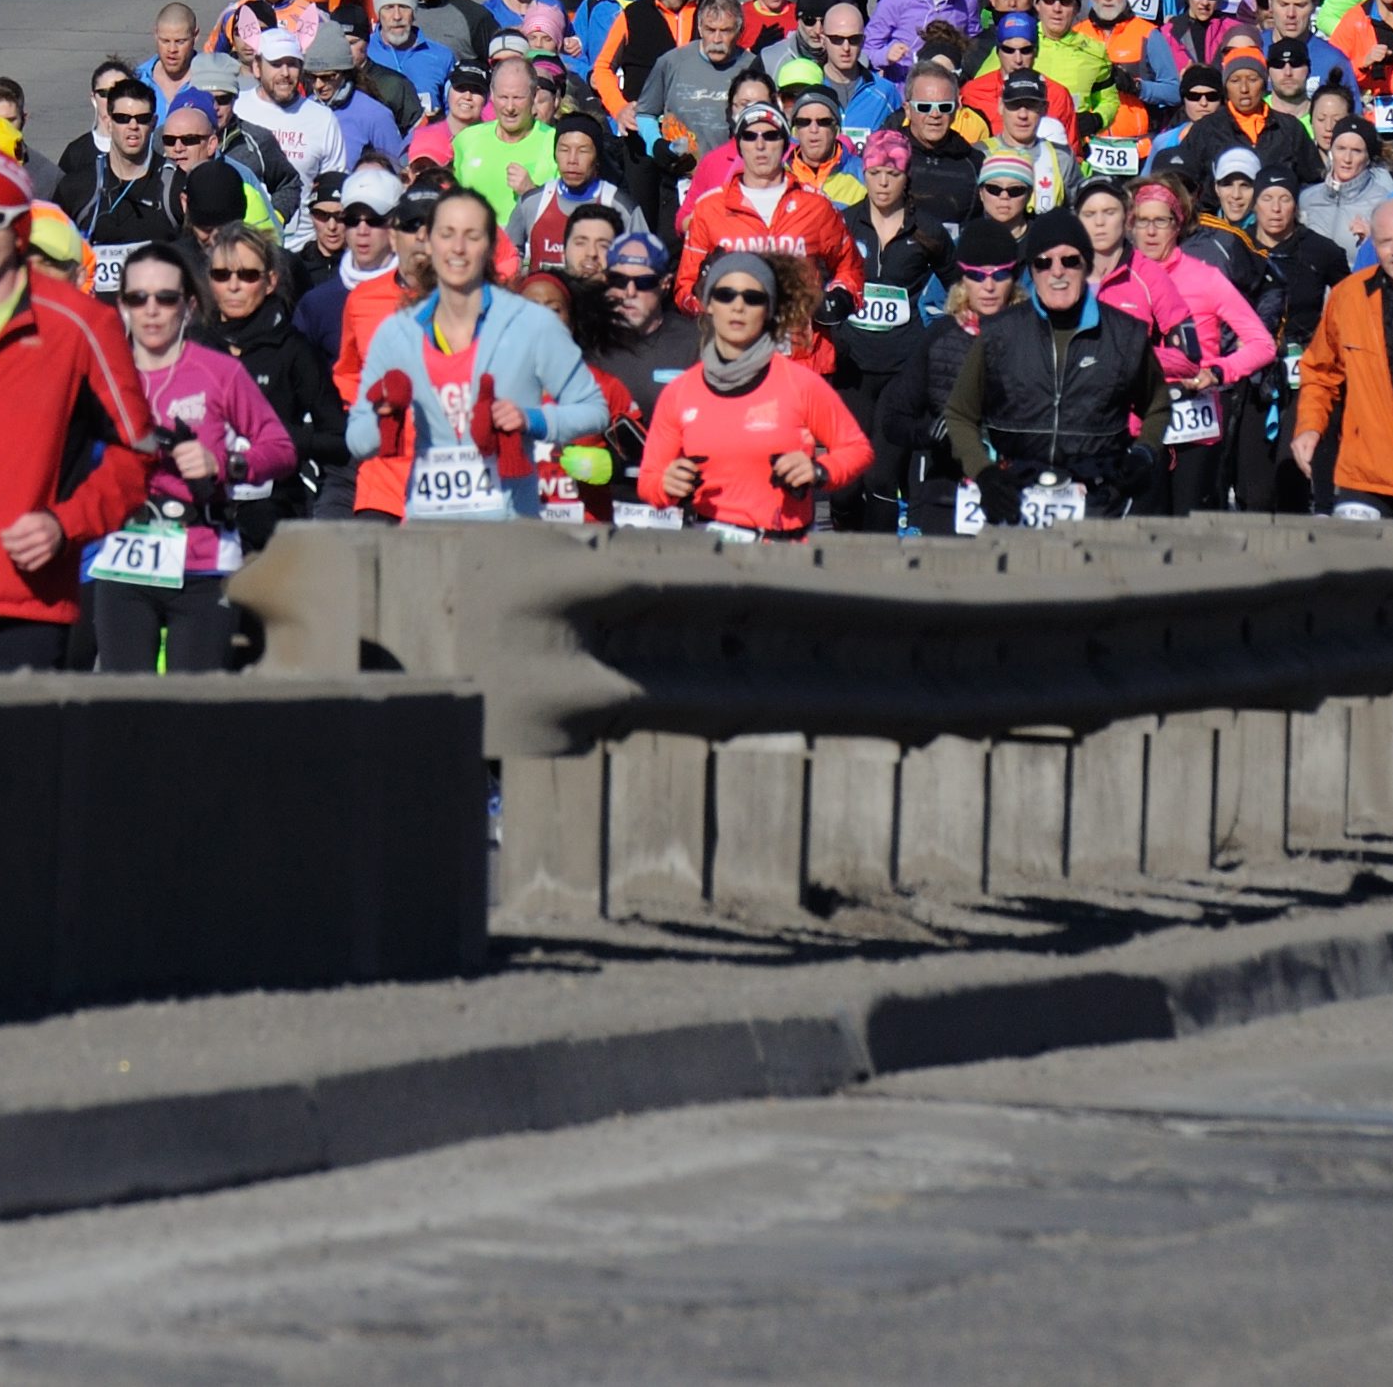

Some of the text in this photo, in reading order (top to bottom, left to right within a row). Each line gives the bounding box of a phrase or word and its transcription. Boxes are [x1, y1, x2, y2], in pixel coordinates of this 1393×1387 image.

[1094, 148, 1128, 168] 758
[718, 236, 806, 256] CANADA
[416, 467, 494, 502] 4994
[546, 510, 571, 519] RUN
[114, 536, 162, 570] 761
